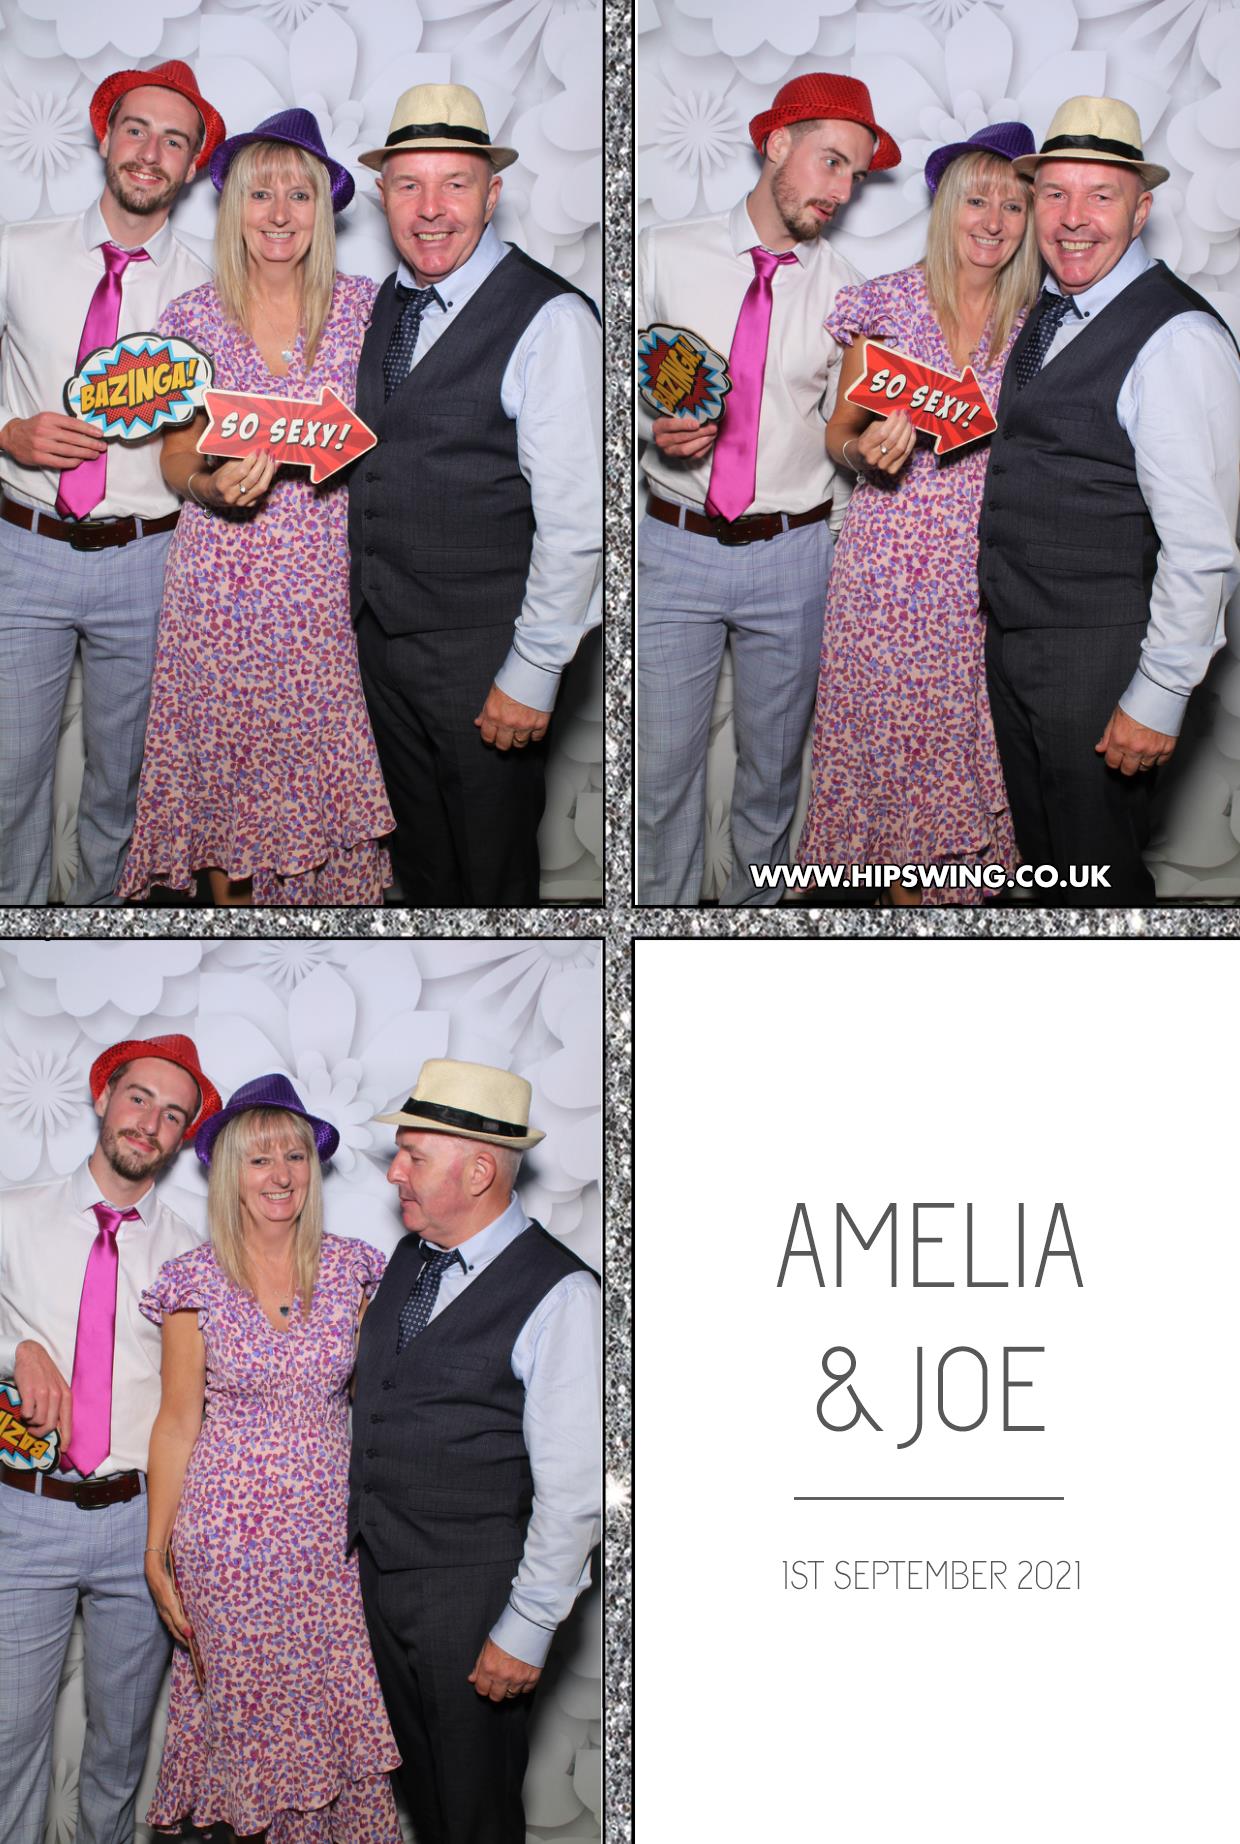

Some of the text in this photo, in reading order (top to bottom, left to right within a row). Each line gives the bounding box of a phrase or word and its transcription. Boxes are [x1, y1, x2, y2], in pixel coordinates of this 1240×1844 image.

[80, 358, 199, 414] BAZINGA!
[651, 335, 703, 412] BAZINGA!
[867, 368, 982, 429] SO SEXY!
[220, 412, 352, 450] SO SEXY!
